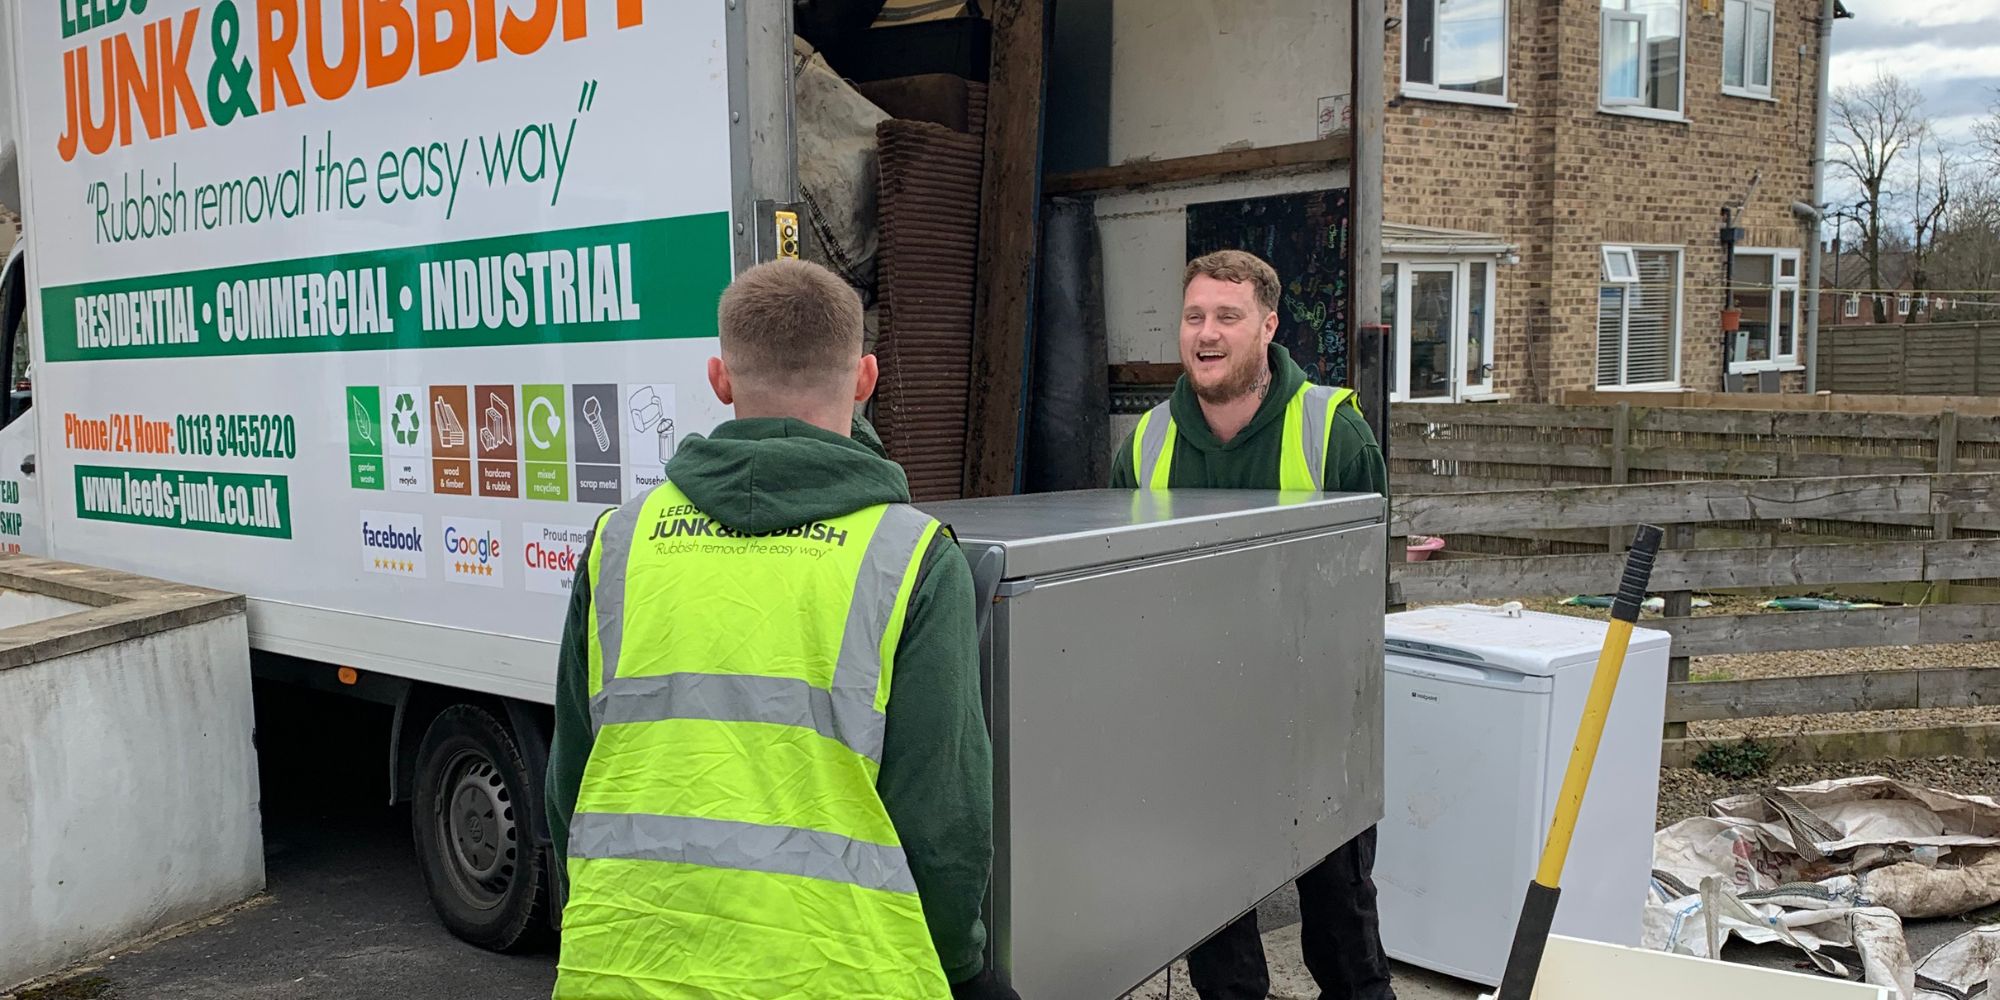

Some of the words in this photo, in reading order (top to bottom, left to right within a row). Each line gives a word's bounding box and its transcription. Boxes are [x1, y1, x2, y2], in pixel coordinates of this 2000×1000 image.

[61, 0, 148, 39] LEE
[194, 135, 307, 231] removal
[315, 130, 367, 212] the
[377, 138, 469, 220] easy
[75, 286, 199, 349] RESIDENTIAL
[216, 266, 394, 342] COMMERCIAL
[419, 243, 641, 331] INDUSTRIAL
[134, 415, 175, 454] Hour:
[176, 414, 213, 455] 0113
[215, 414, 296, 459] 3455220
[358, 463, 376, 473] garden
[443, 466, 460, 477] wood
[484, 468, 511, 479] hardcore
[537, 469, 556, 480] mixed
[360, 476, 375, 484] waste
[399, 476, 417, 486] recycle
[445, 478, 465, 489] timber
[492, 481, 511, 492] rubble
[580, 479, 597, 491] scrap
[599, 479, 618, 490] metal
[0, 480, 19, 504] EAD
[533, 482, 561, 495] recycling
[81, 471, 282, 529] www.leeds-junk.co.uk
[659, 504, 701, 518] LEEDS
[362, 521, 423, 552] facebook
[543, 527, 568, 542] Proud
[444, 526, 500, 564] Google
[700, 541, 749, 555] removal
[750, 541, 767, 554] the
[769, 544, 798, 557] easy
[525, 542, 581, 571] Check
